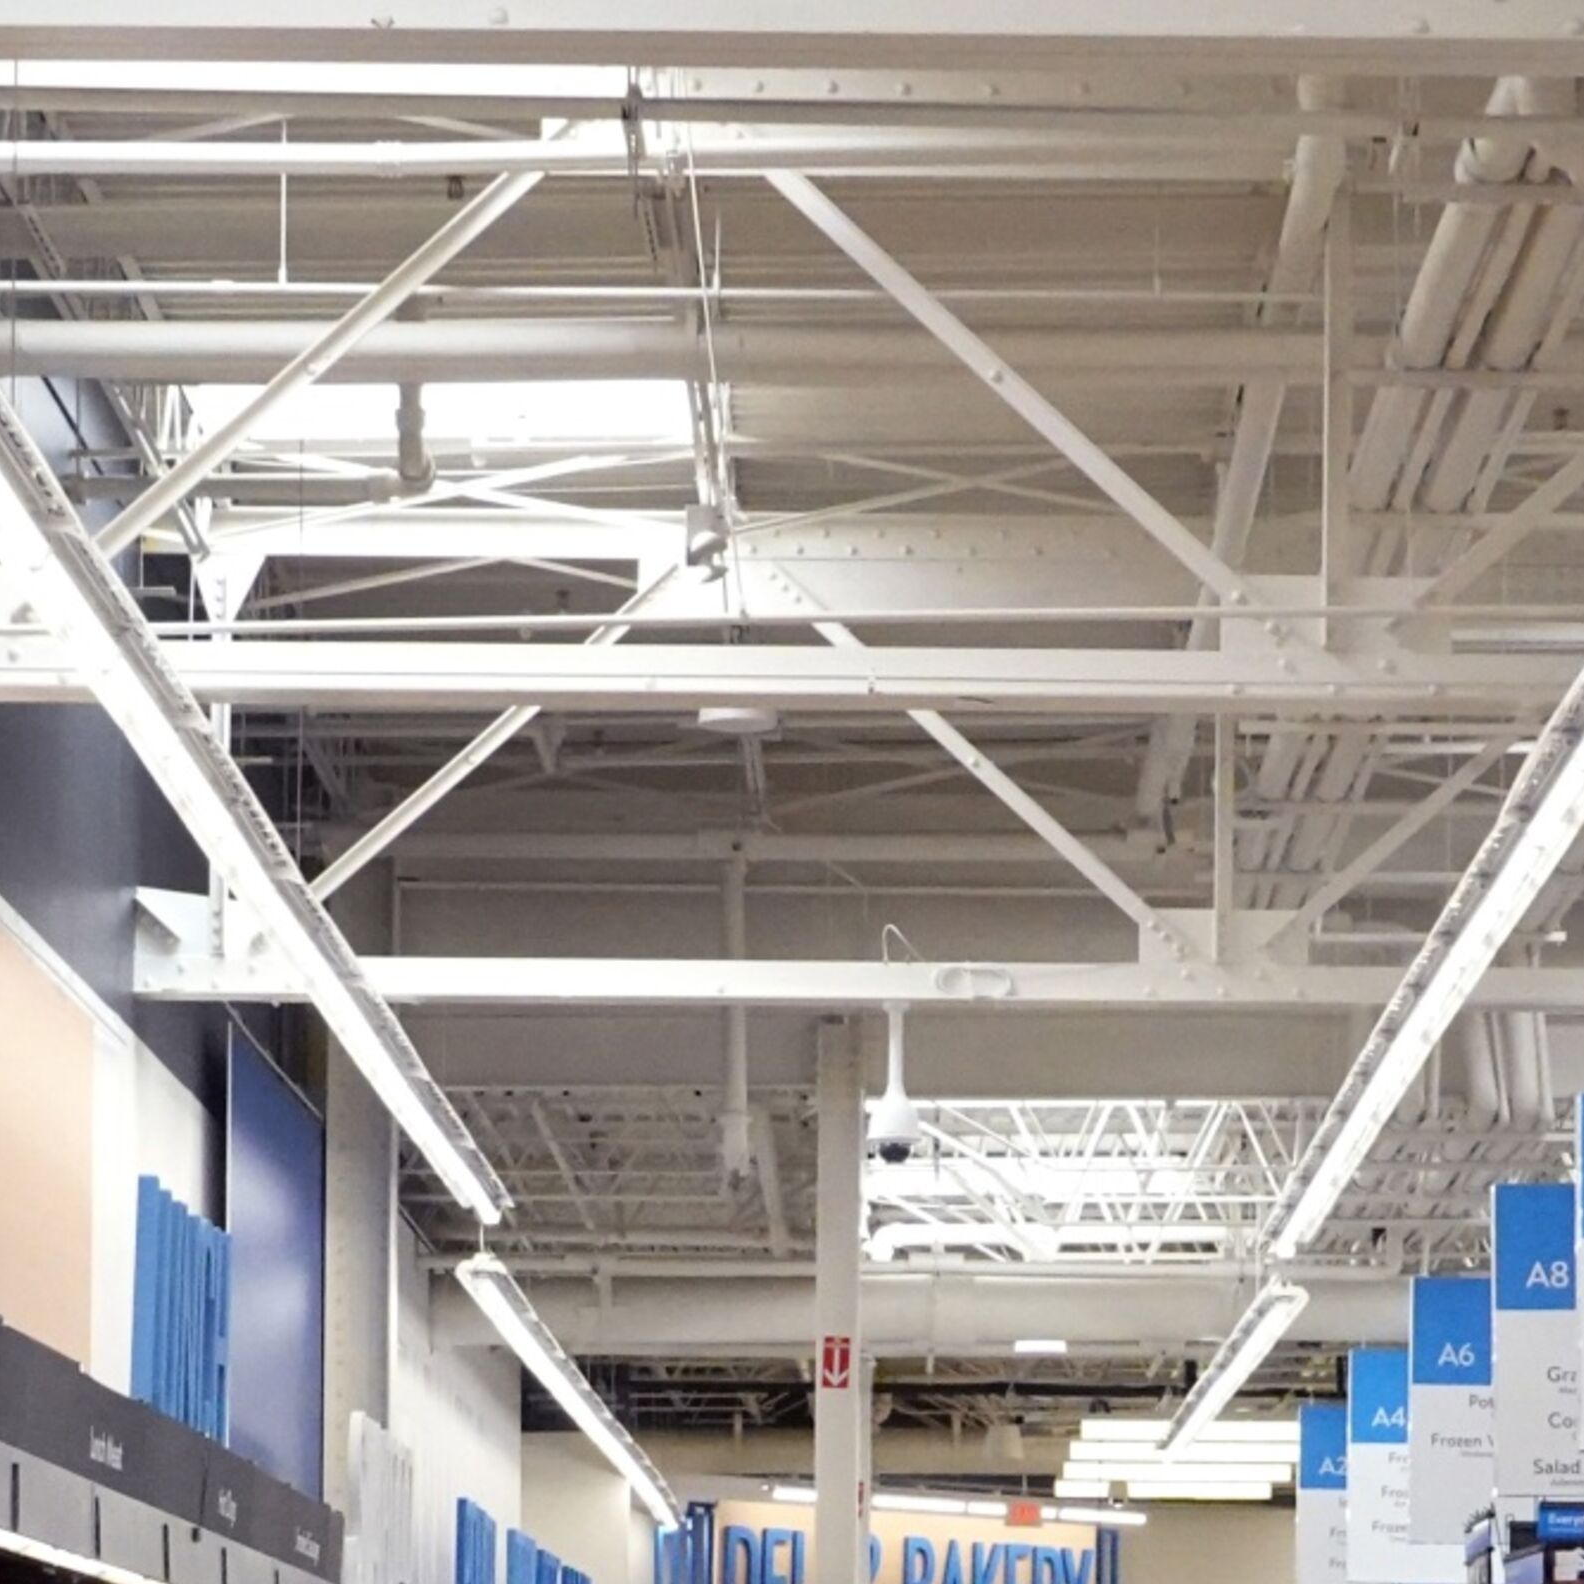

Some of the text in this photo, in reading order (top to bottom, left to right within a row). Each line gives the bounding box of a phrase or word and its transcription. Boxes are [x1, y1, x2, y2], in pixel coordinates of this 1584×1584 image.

[1525, 1261, 1569, 1289] A8
[1438, 1342, 1475, 1367] A6
[1371, 1406, 1406, 1428] A4
[1431, 1433, 1482, 1449] Frozen
[1533, 1458, 1582, 1475] Salad
